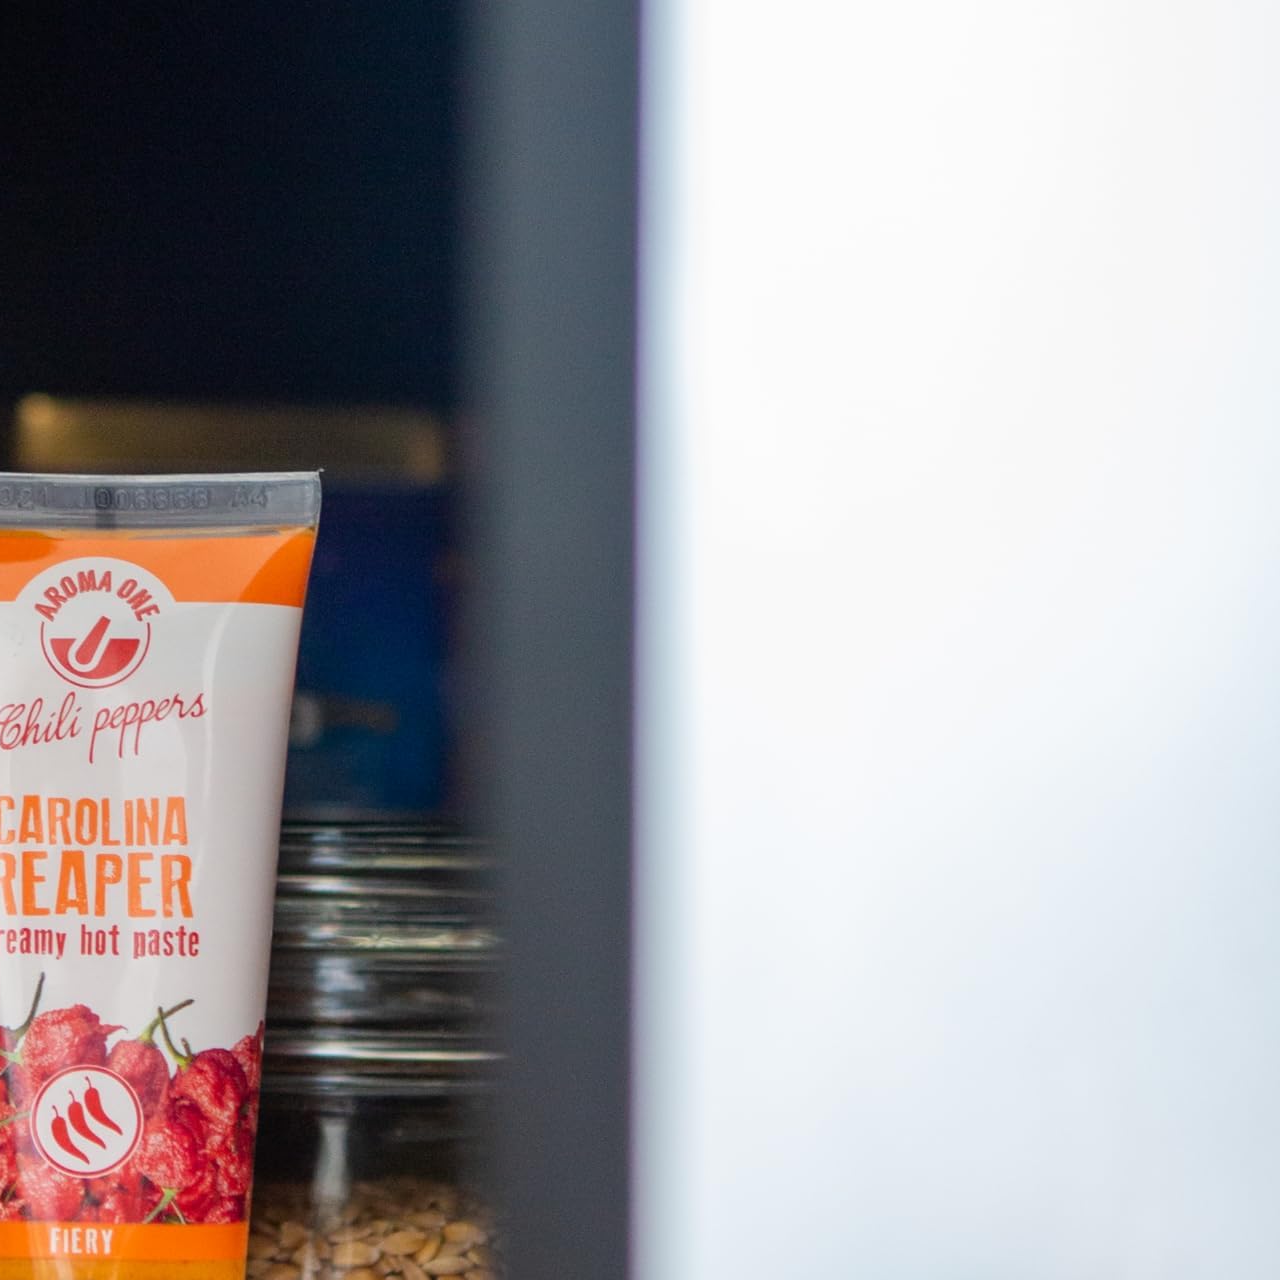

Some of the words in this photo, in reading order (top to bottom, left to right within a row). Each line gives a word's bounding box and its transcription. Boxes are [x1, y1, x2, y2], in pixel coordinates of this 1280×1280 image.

[34, 569, 112, 622] AROMA
[116, 578, 160, 622] ONE
[88, 691, 208, 764] peppers
[80, 925, 120, 956] hot
[132, 925, 201, 959] paste
[50, 1227, 114, 1255] FIERY
